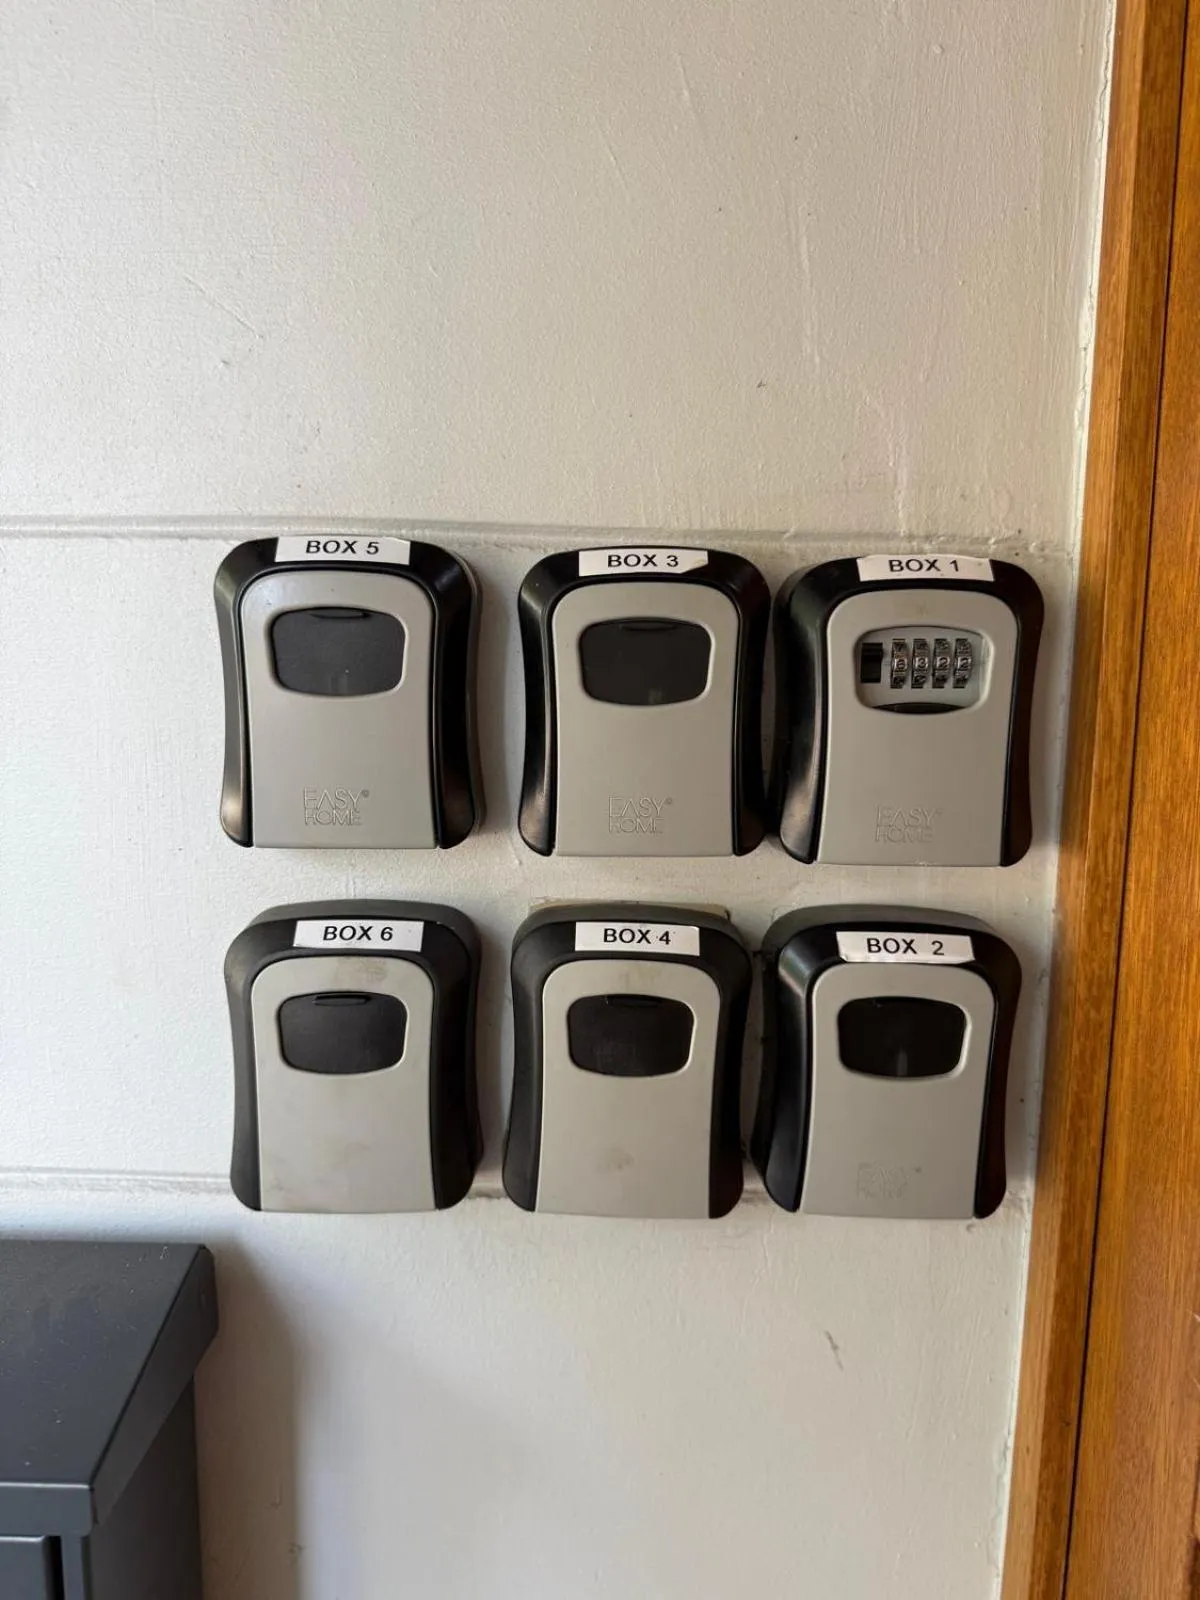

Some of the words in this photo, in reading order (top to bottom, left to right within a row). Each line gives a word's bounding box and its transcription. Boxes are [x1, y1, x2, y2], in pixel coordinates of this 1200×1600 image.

[306, 540, 357, 554] BOX
[366, 541, 380, 555] 5
[607, 554, 658, 568] BOX
[666, 554, 680, 568] 3
[888, 559, 941, 573] BOX
[949, 559, 960, 573] 1
[304, 809, 362, 826] HOME
[323, 926, 374, 941] BOX
[380, 926, 394, 941] 6
[603, 928, 652, 945] BOX
[658, 930, 672, 945] 4
[866, 938, 918, 954] BOX
[931, 940, 945, 956] 2
